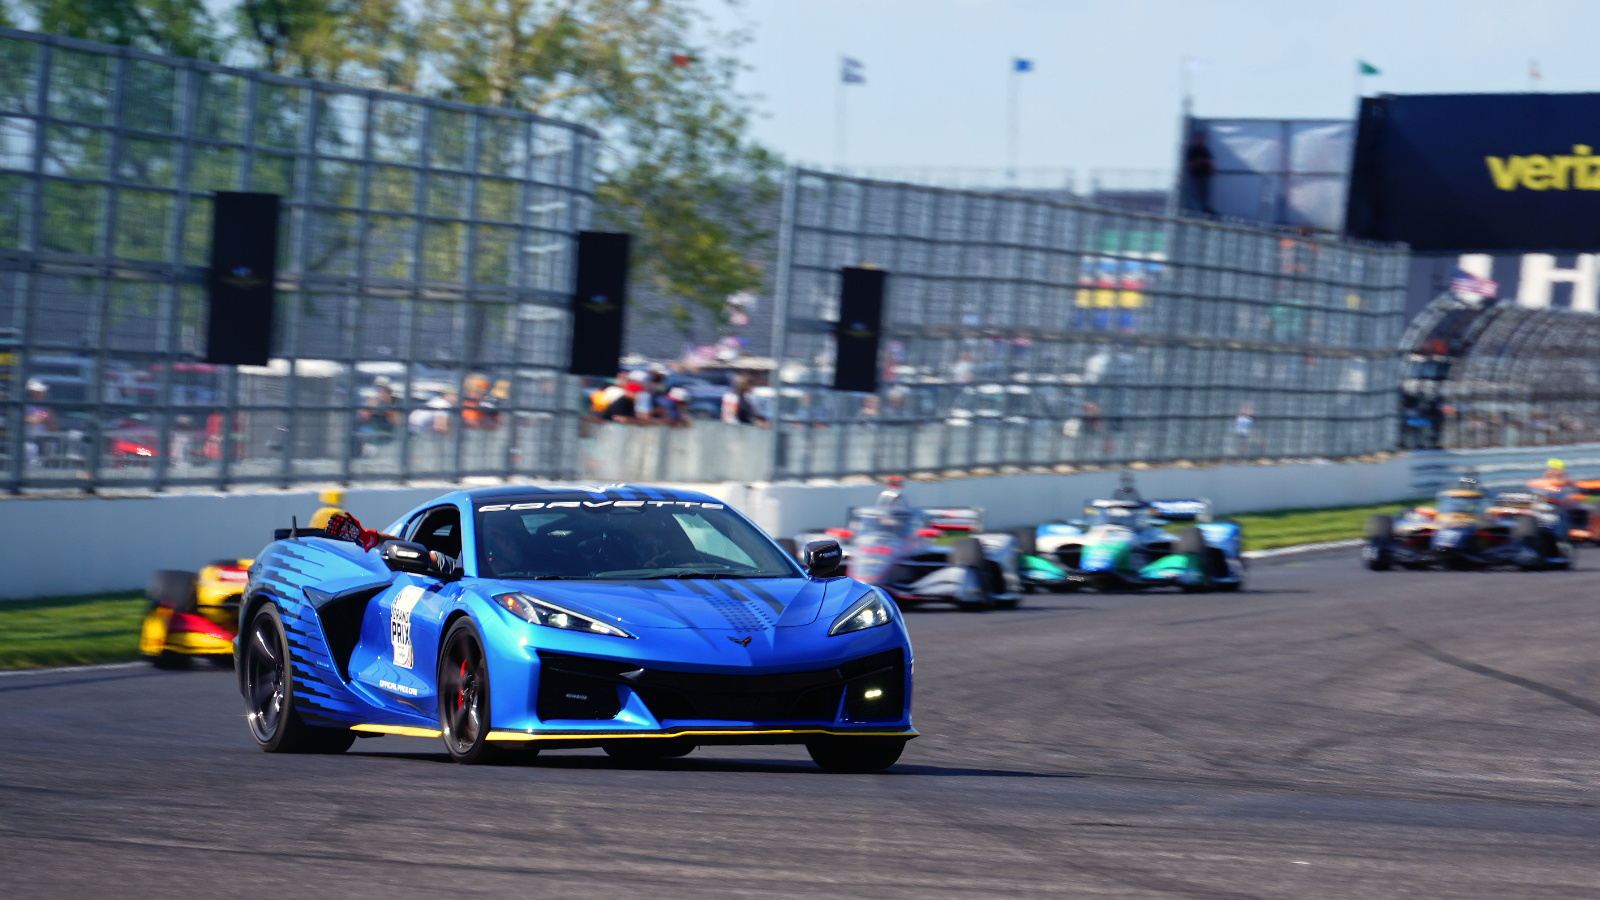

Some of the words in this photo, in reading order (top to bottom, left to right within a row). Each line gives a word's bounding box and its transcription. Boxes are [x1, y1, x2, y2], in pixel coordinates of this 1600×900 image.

[478, 500, 724, 513] CORVETTE
[391, 621, 410, 646] PRIX
[379, 679, 397, 691] OFFICIAL
[397, 684, 409, 694] PACE
[408, 687, 418, 697] CAR
